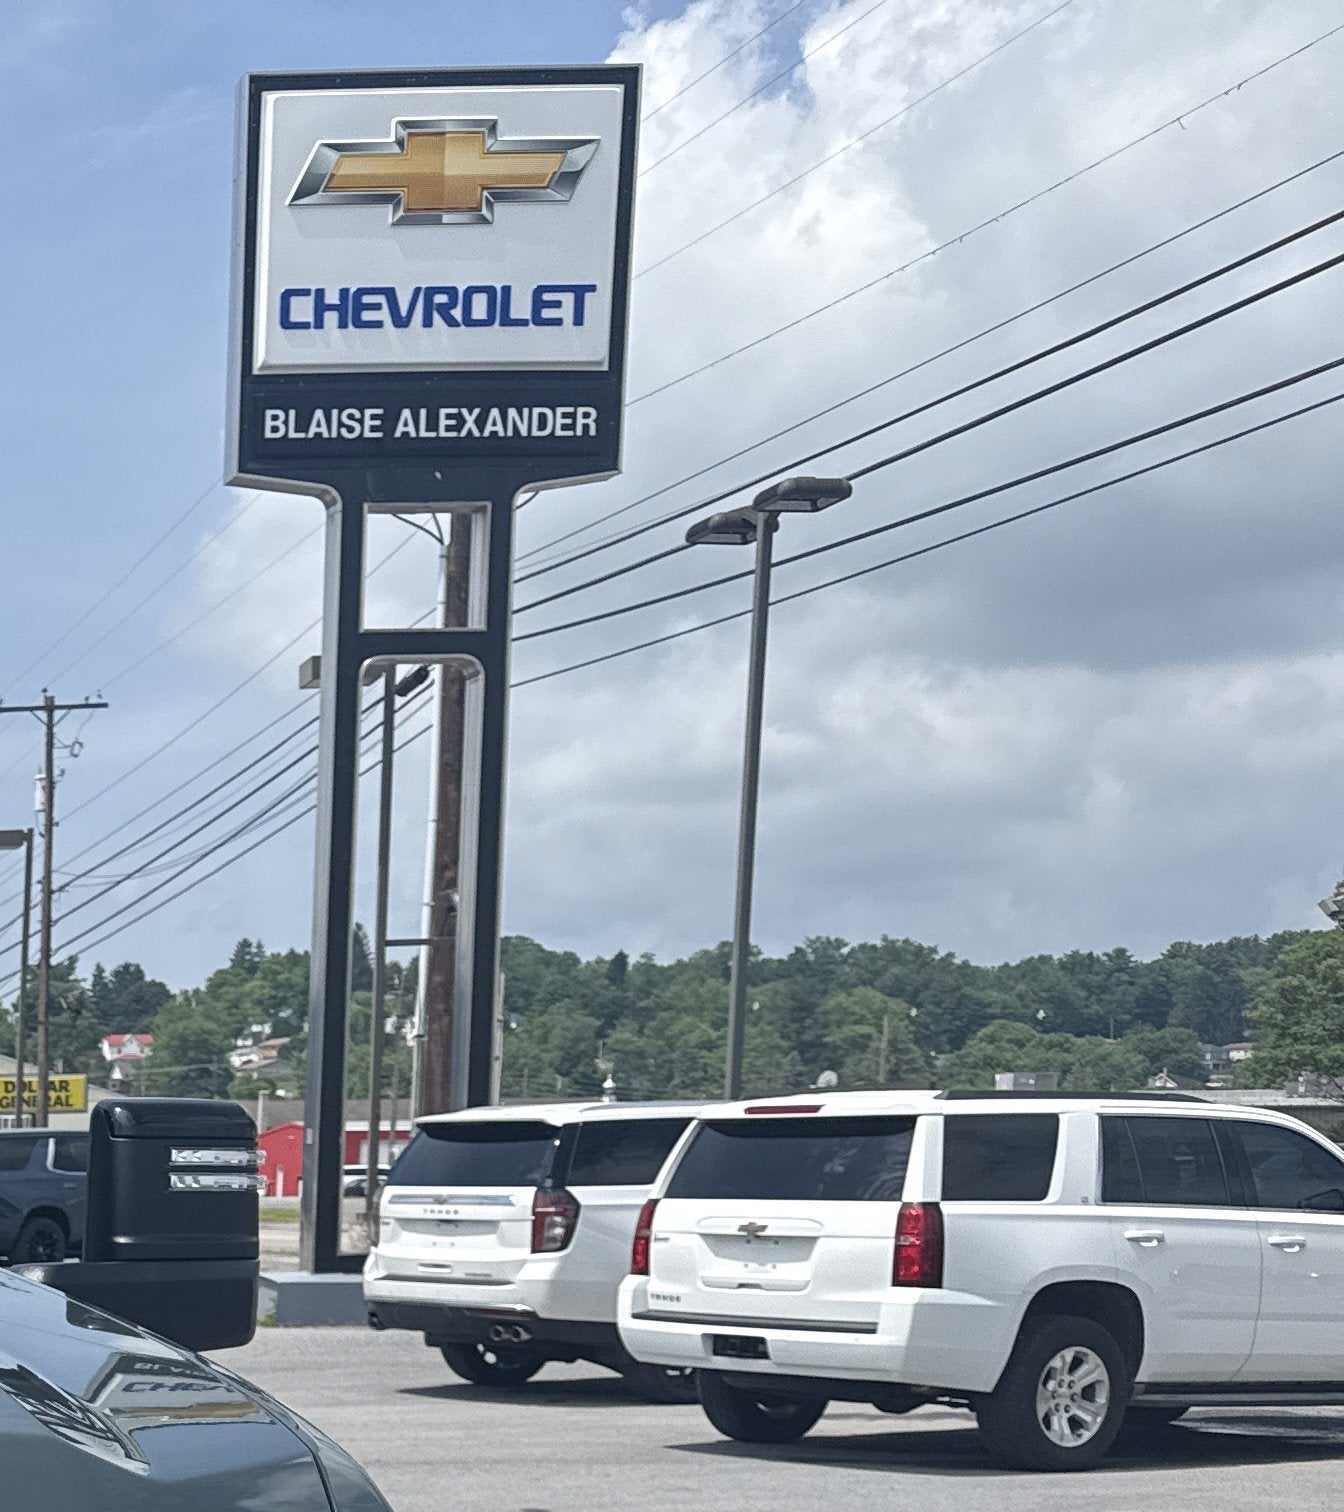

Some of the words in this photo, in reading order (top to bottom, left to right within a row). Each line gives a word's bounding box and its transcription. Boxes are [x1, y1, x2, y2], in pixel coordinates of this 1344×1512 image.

[279, 284, 597, 330] CHEVROLET
[264, 408, 384, 439] BLAISE
[393, 406, 598, 438] ALEXANDER
